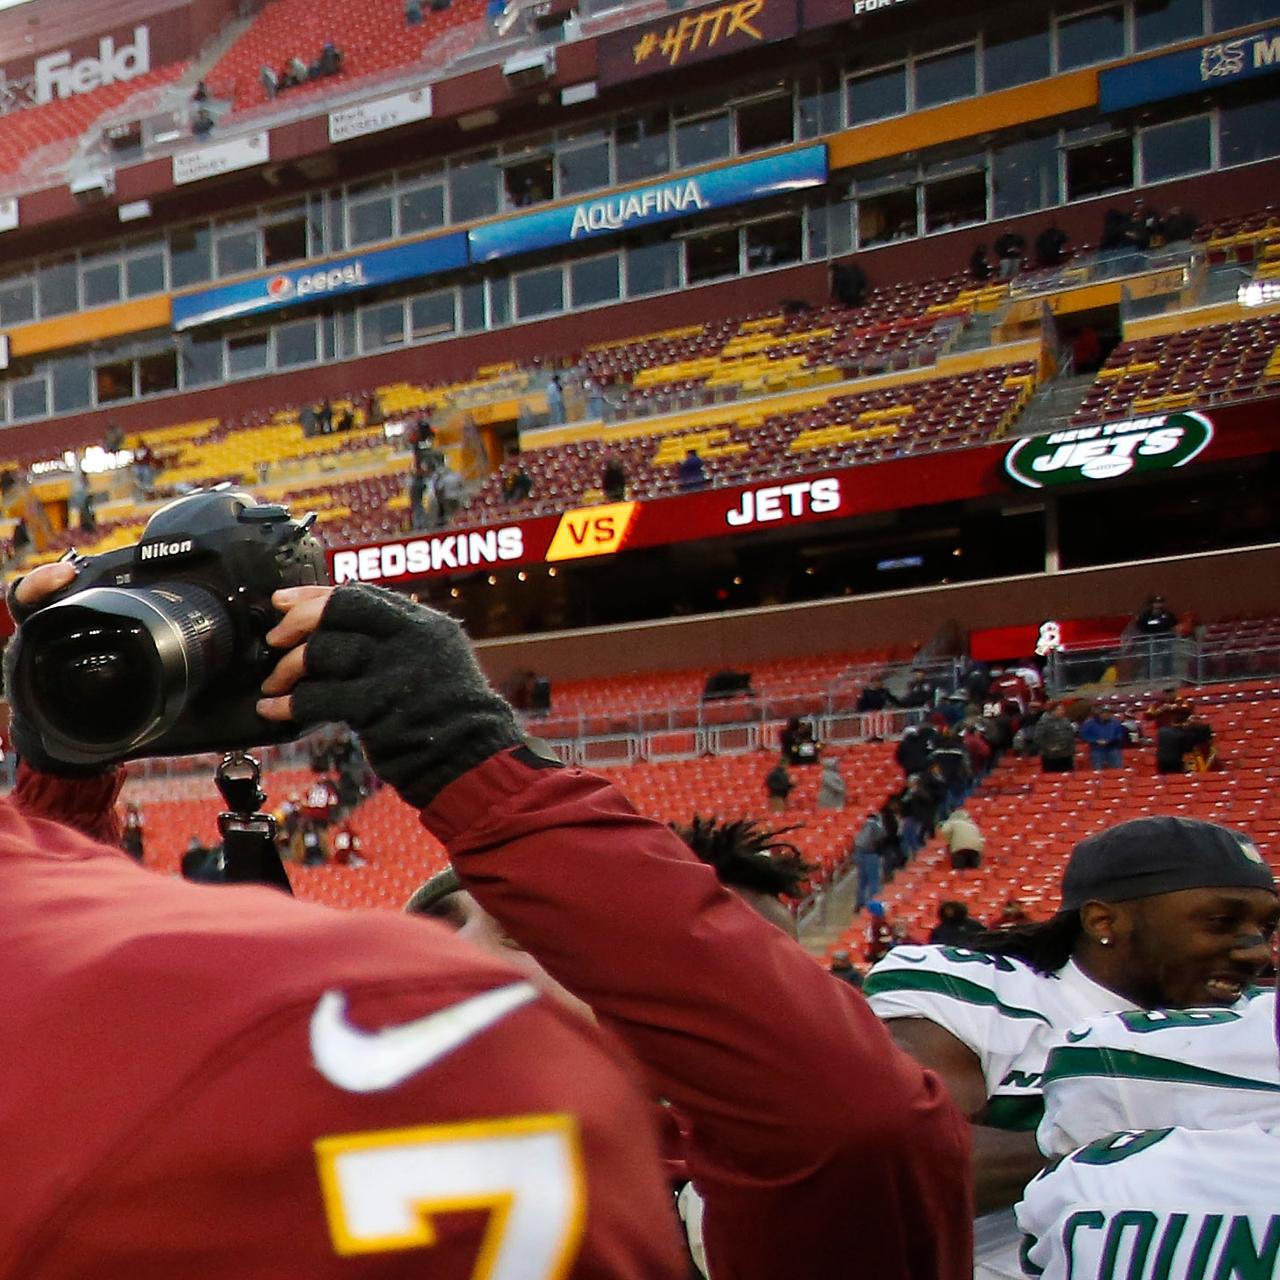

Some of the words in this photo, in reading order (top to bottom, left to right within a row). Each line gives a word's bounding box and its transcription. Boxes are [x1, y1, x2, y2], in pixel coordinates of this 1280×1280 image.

[570, 180, 706, 239] AQUAFINA
[297, 263, 365, 296] pepsi
[1032, 427, 1186, 472] JETS
[1046, 427, 1101, 445] NEW
[1103, 416, 1168, 436] YORK
[726, 477, 841, 528] JETS
[141, 539, 193, 561] Nikon
[333, 526, 524, 584] REDSKINS
[567, 517, 616, 545] VS
